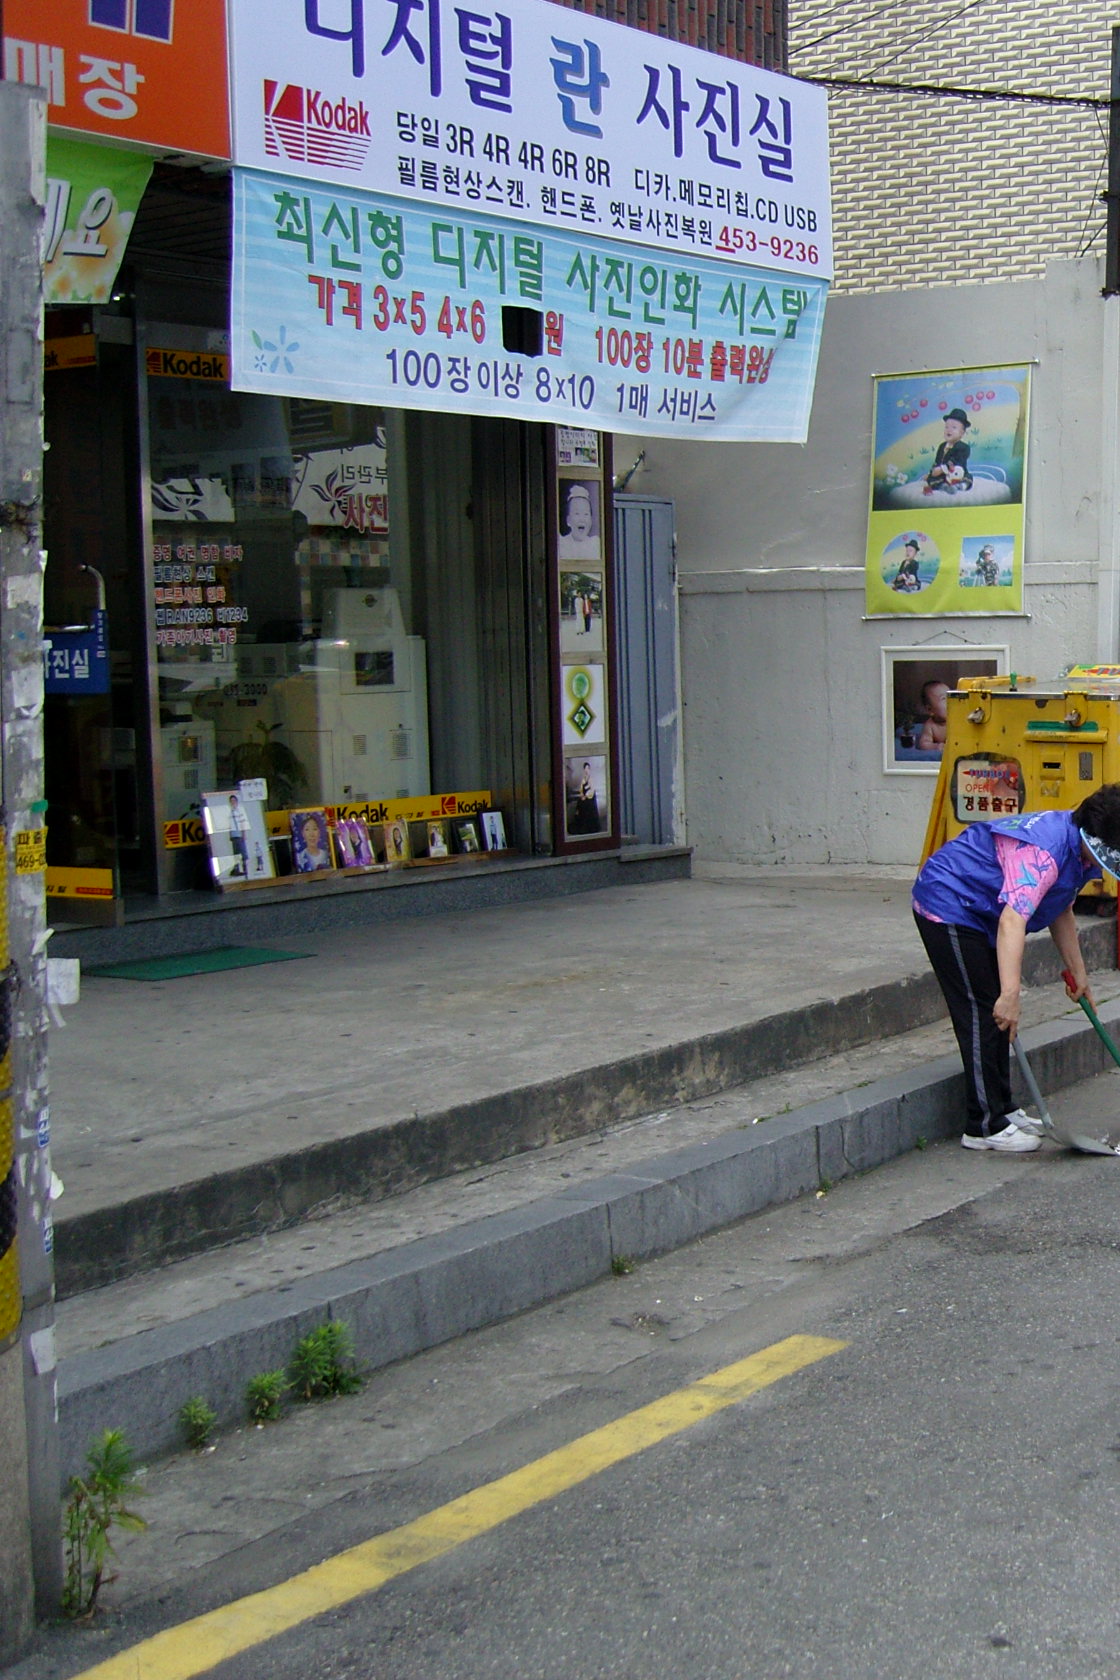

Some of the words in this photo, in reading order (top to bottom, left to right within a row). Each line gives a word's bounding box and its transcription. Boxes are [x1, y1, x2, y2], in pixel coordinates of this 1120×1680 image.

[3, 37, 145, 120] 매장
[306, 89, 371, 137] Kodak
[548, 35, 609, 139] 란
[636, 63, 794, 183] 사진실
[396, 111, 439, 148] 당일
[446, 123, 474, 158] 3R
[483, 133, 511, 166] 4R
[518, 140, 545, 173] 4R
[552, 148, 578, 181] 6R
[585, 157, 611, 187] 8R
[784, 206, 818, 233] USB
[273, 191, 405, 280] 최신형
[432, 222, 544, 302] 디지털
[566, 251, 702, 330] 사진인화
[718, 225, 819, 264] 453-9236
[308, 274, 363, 330] 가격
[595, 326, 653, 374] 100장
[662, 337, 705, 379] 10분
[162, 353, 224, 379] Kodak
[616, 383, 649, 418] 1매
[657, 387, 717, 423] 서비스
[45, 649, 89, 678] 진실
[963, 796, 1017, 813] 경품출구
